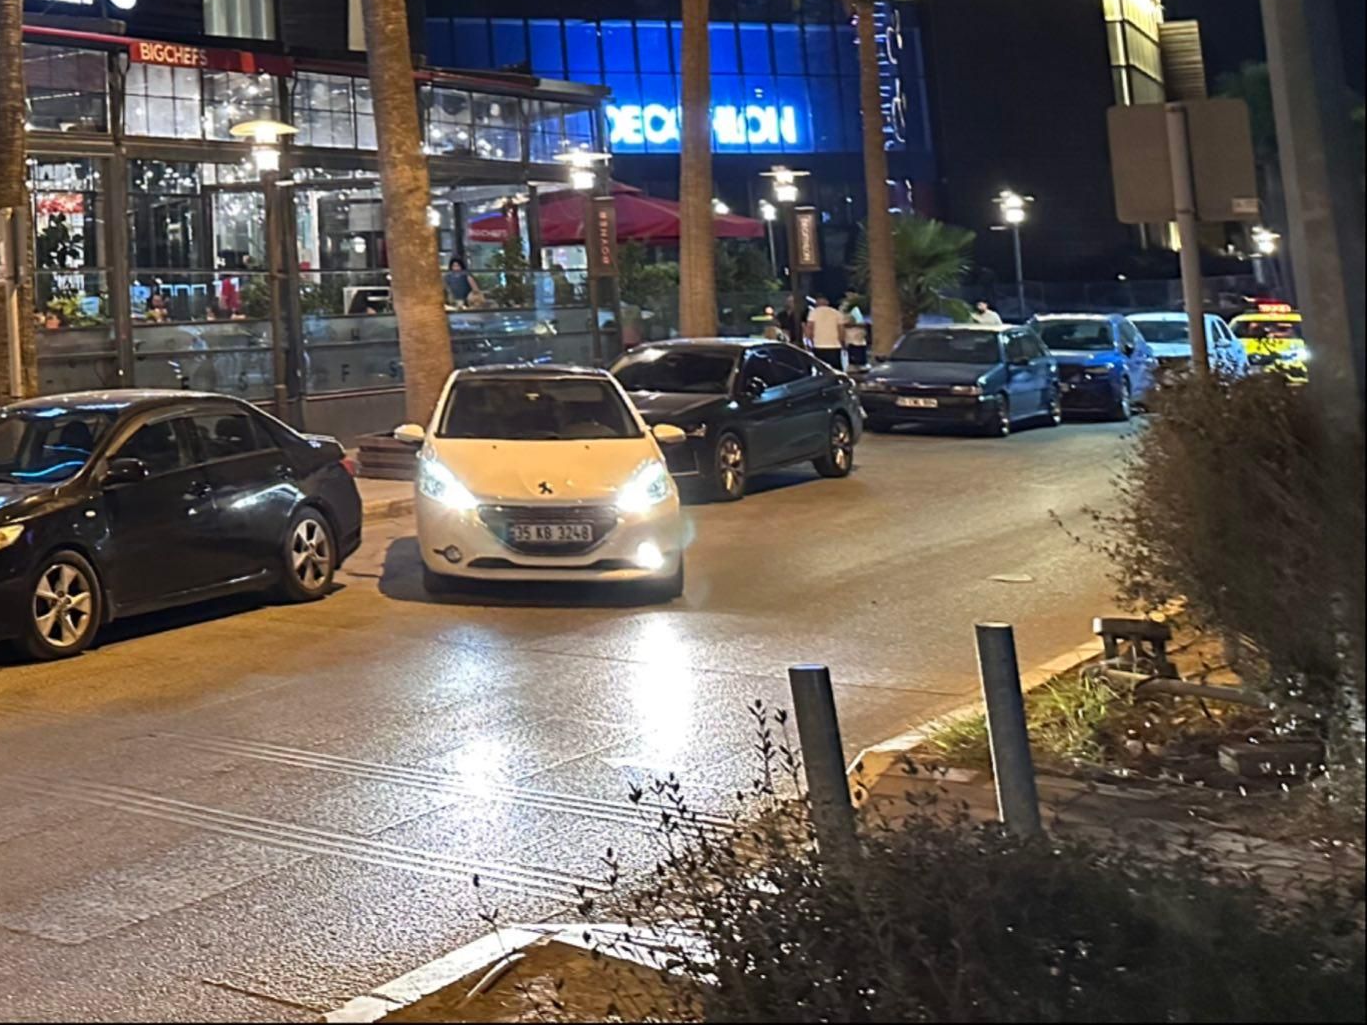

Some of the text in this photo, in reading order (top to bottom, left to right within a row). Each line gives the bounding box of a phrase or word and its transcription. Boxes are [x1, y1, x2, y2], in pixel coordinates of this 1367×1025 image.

[139, 42, 208, 66] BIGCHEFS
[605, 104, 798, 144] DECAHLON
[516, 526, 531, 540] 35
